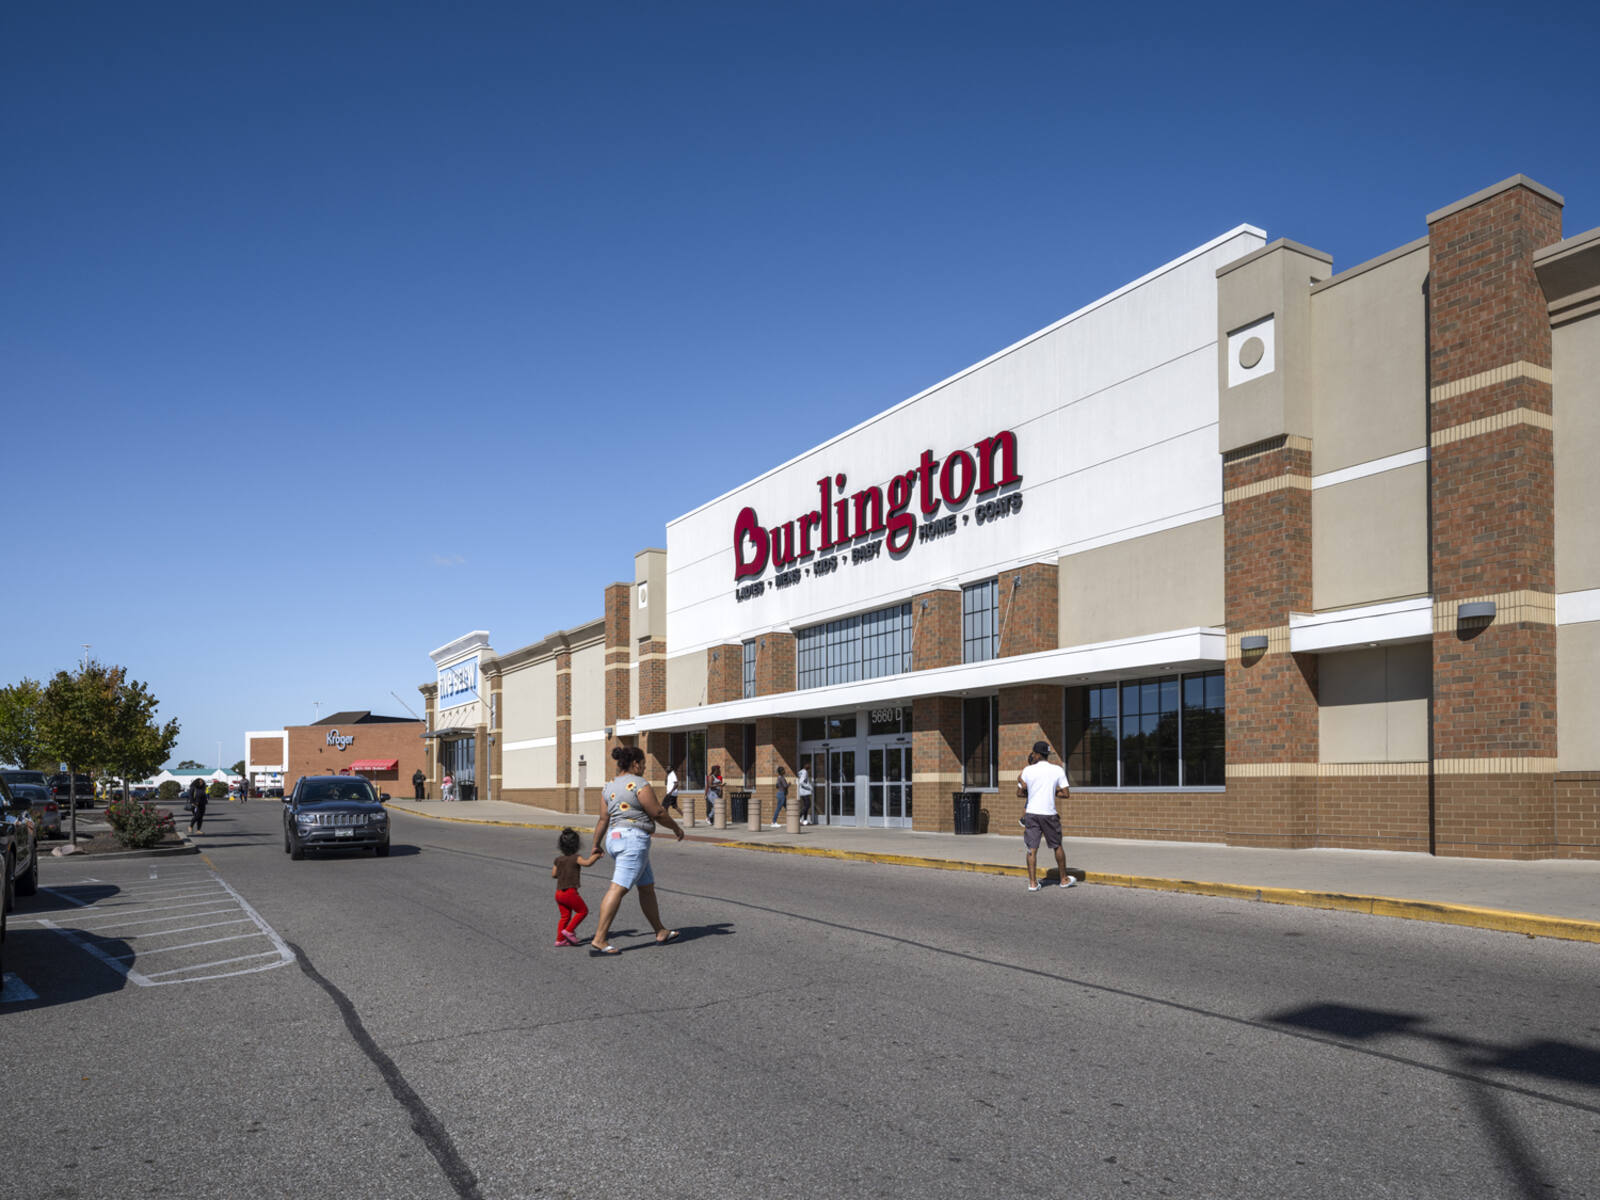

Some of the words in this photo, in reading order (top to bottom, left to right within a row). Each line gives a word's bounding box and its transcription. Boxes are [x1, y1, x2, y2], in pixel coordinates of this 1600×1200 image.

[733, 430, 1023, 581] Burlington
[735, 581, 765, 601] LADIES
[813, 556, 838, 576] KIDS
[852, 540, 882, 564] BABY
[918, 514, 957, 541] HOME
[975, 492, 1023, 525] COATS
[326, 729, 354, 751] Kroger
